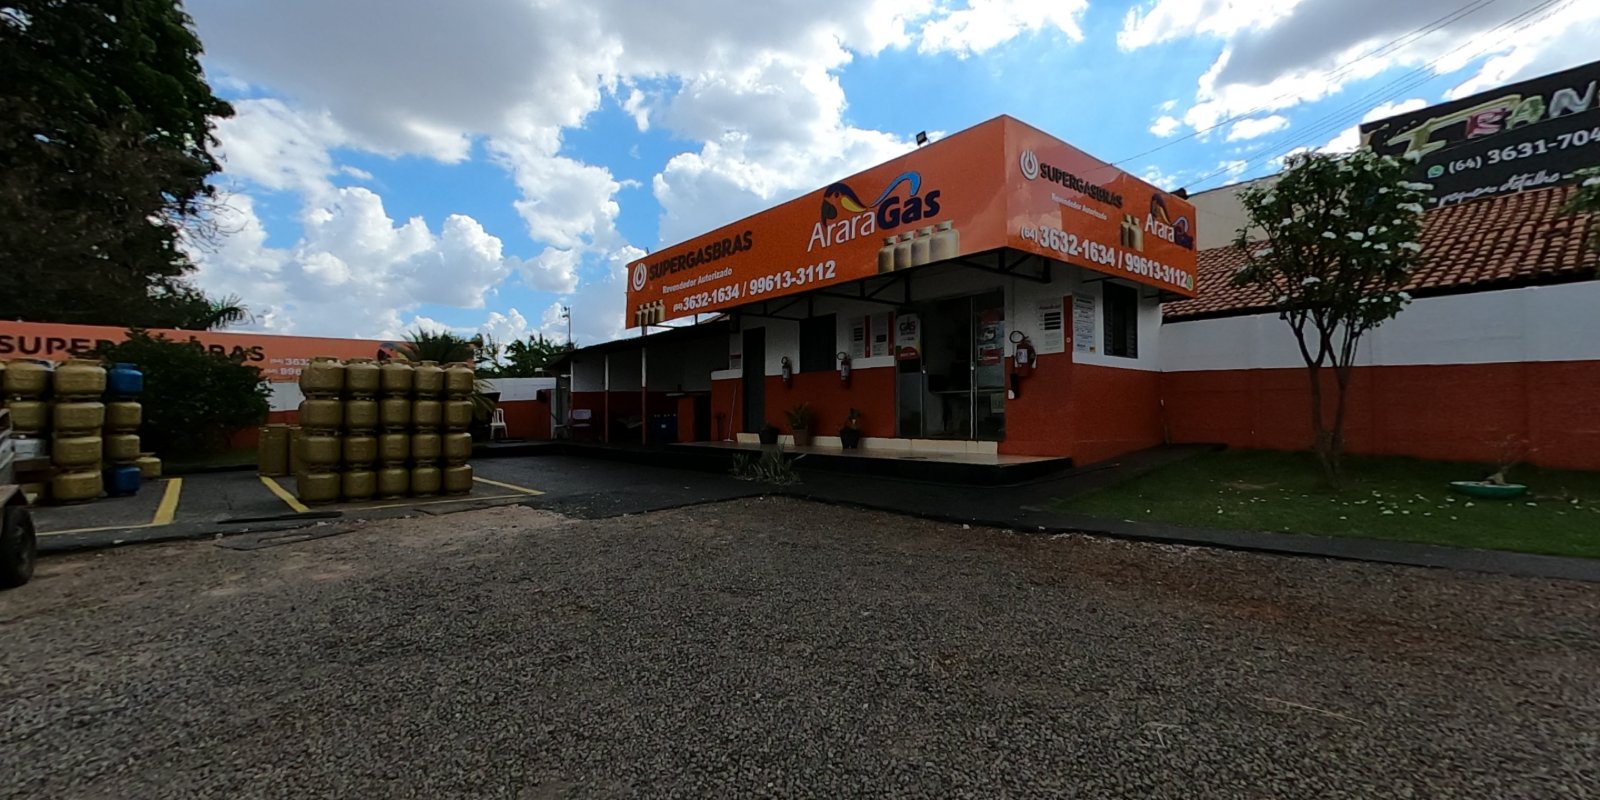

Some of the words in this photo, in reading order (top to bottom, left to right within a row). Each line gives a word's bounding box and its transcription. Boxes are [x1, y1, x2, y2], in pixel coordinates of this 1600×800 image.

[1386, 80, 1600, 164] TRAN
[1040, 163, 1123, 208] SUPERGASBRAS
[1449, 155, 1482, 174] (64)
[807, 190, 941, 252] AraraGas
[649, 230, 753, 281] SUPERGASBRAS
[662, 278, 697, 294] Revendedor
[697, 267, 733, 285] Autorizado
[1020, 225, 1038, 243] (64)
[1039, 225, 1115, 267] 3632-1634
[1117, 250, 1123, 269] /
[1125, 253, 1187, 287] 99613-3112
[682, 283, 739, 311] 3632-1634
[749, 260, 836, 296] 99613-3112
